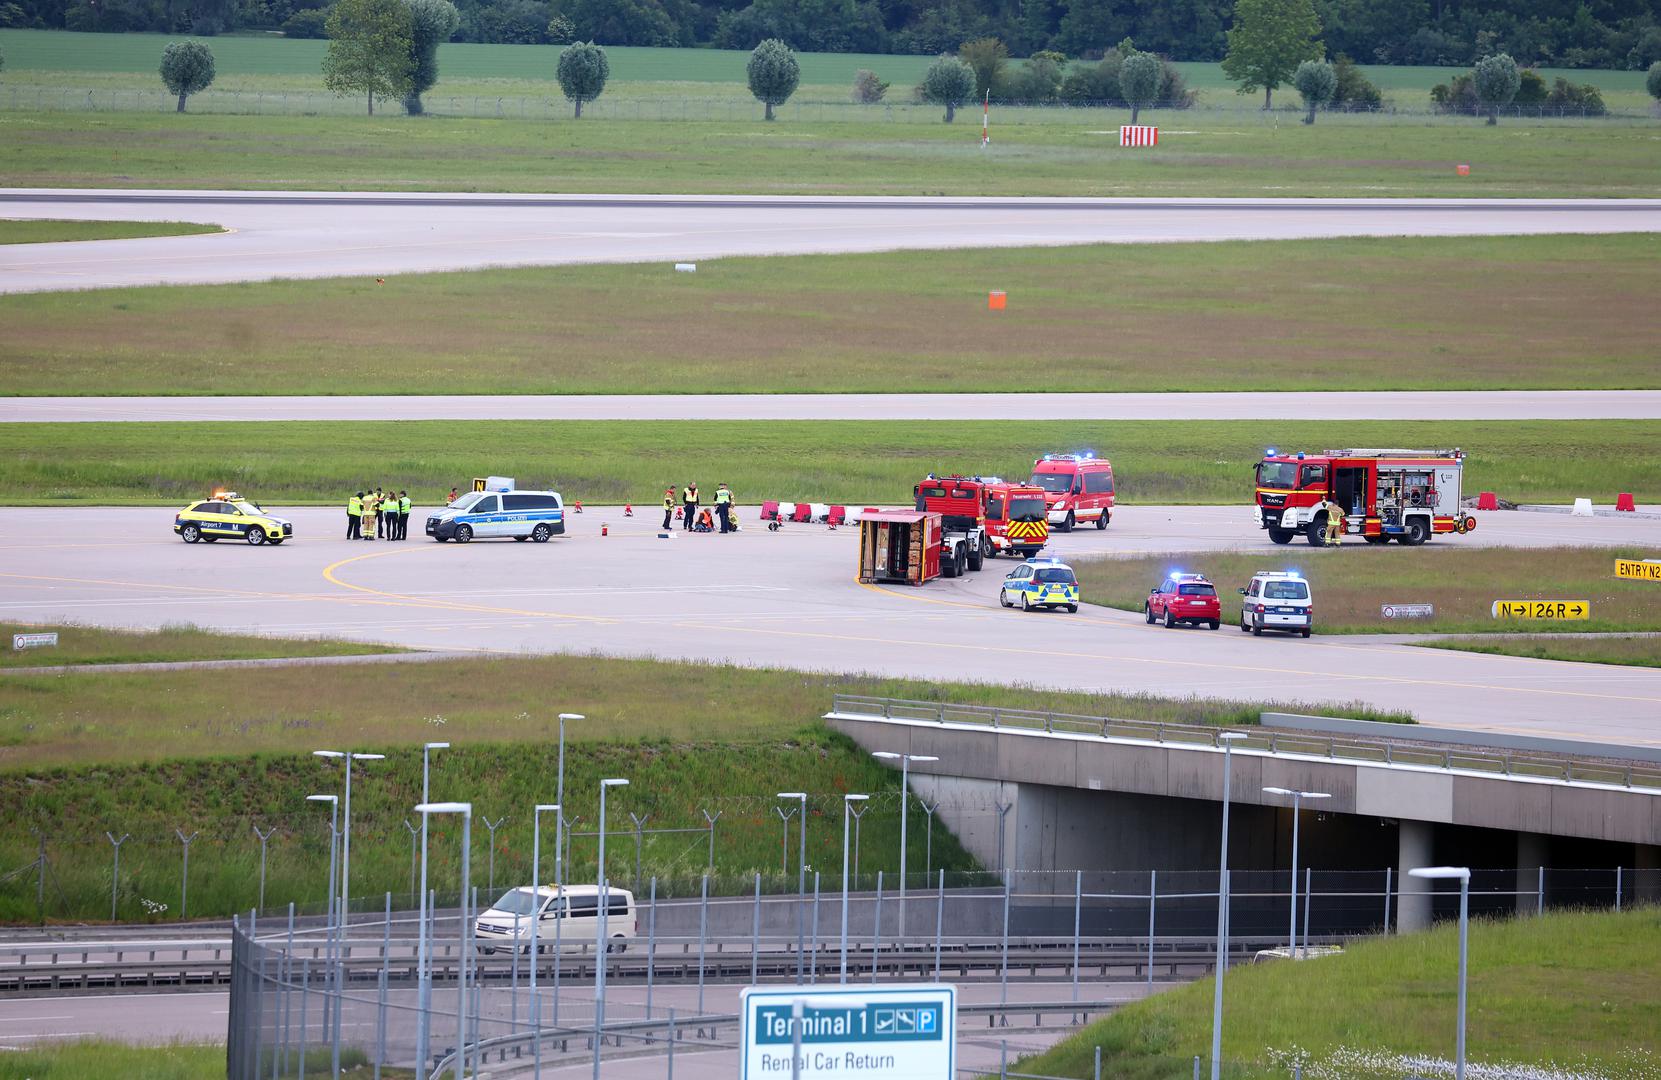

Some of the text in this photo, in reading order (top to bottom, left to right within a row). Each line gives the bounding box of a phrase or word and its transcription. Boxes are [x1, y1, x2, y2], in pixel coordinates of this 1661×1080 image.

[476, 480, 484, 492] N
[200, 521, 217, 529] Airport
[1620, 562, 1661, 579] ENTRY N2
[1502, 602, 1512, 618] N
[762, 1009, 867, 1037] Terminal 1
[920, 1012, 931, 1031] P
[762, 1052, 894, 1071] Renal Car Return
